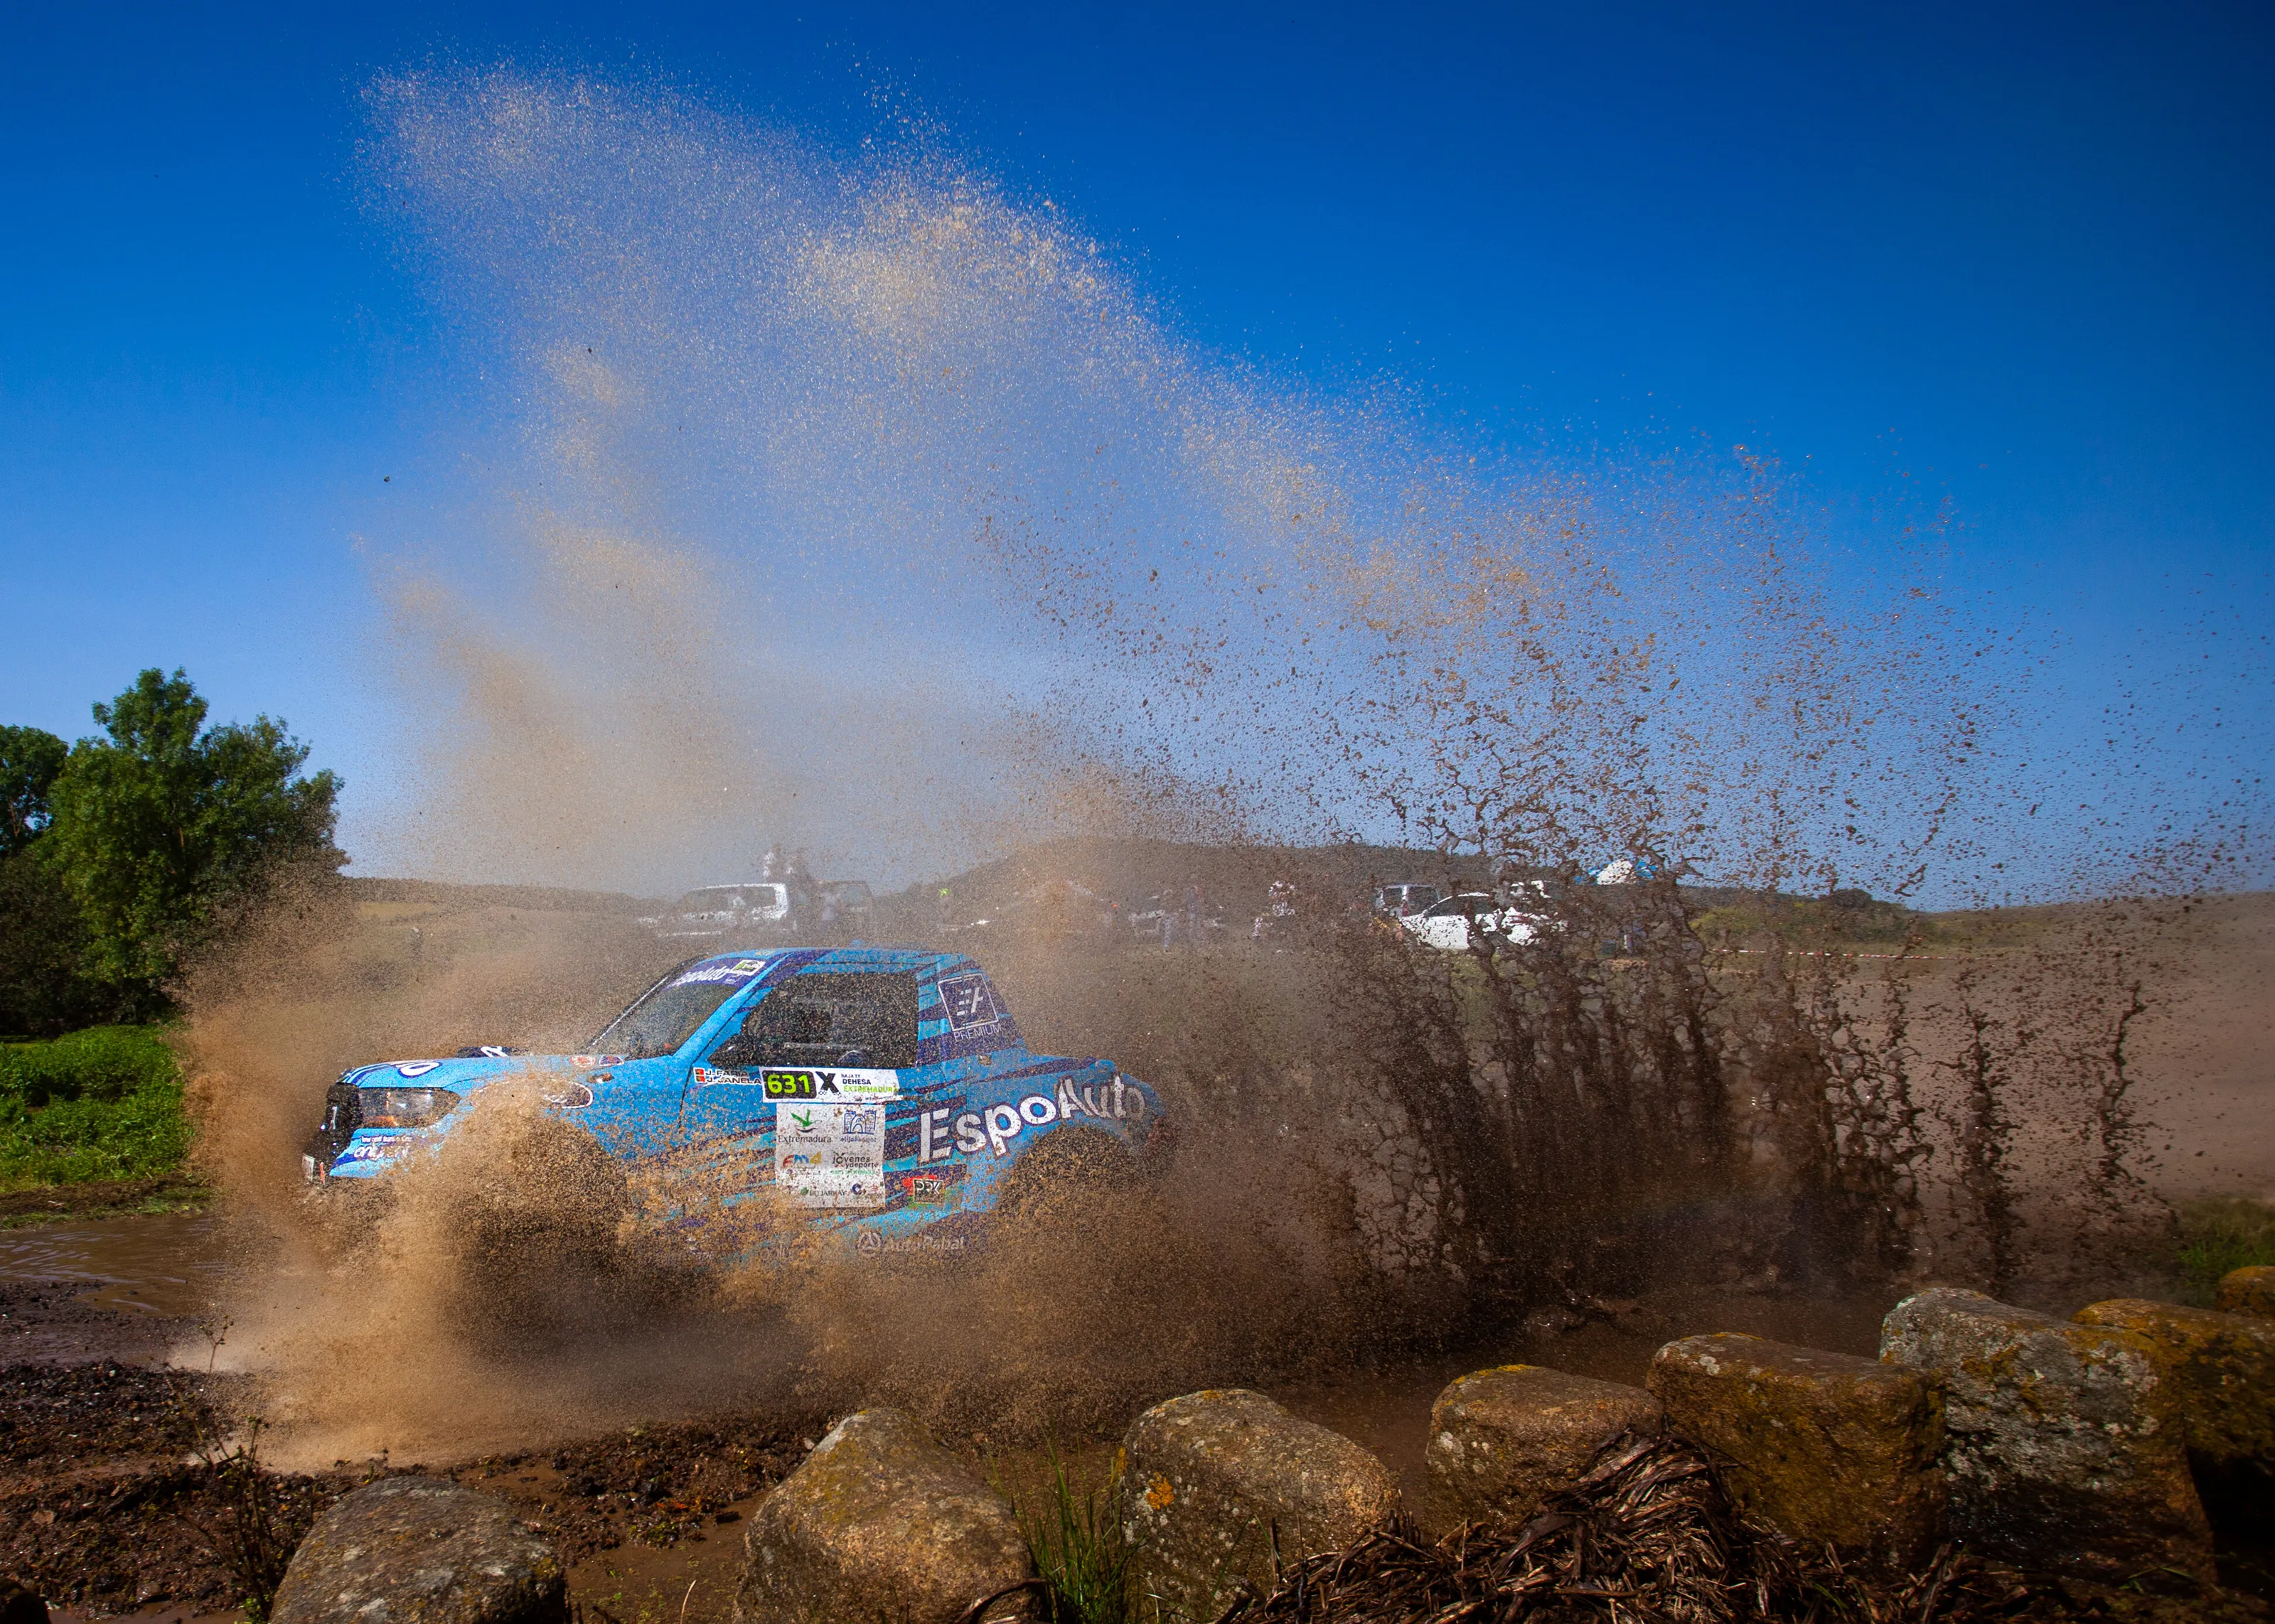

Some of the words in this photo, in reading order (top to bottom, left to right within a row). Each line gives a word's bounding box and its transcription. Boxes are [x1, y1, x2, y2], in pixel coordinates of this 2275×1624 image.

[953, 1022, 1002, 1041] PREMIUM
[767, 1074, 810, 1094] 631
[919, 1071, 1146, 1163] EspoAuto
[778, 1135, 833, 1144] Extremadura
